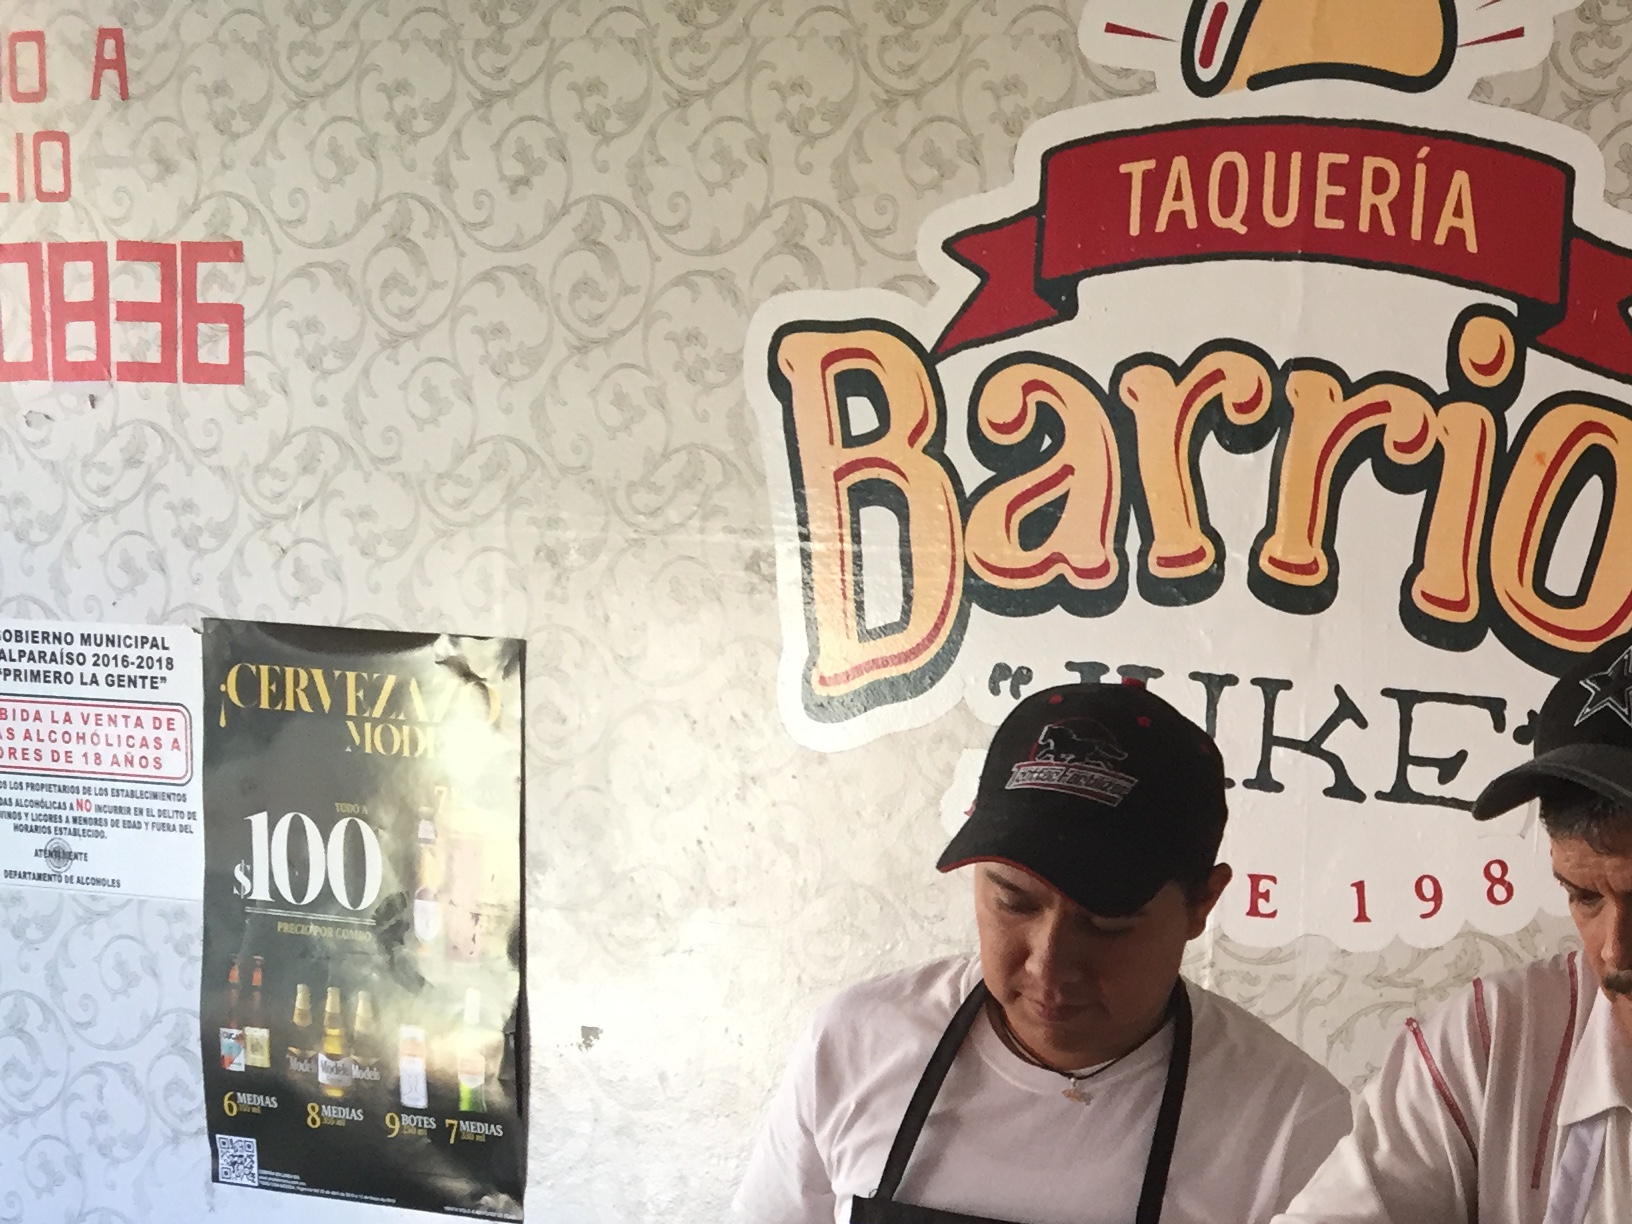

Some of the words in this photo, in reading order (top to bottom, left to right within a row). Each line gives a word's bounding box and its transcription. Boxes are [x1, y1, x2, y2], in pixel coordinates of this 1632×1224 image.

[91, 28, 129, 101] A
[0, 130, 71, 203] IO
[1119, 147, 1478, 253] TAQUERÍA
[0, 629, 74, 646] OBIERNO
[80, 633, 169, 650] MUNICIPAL
[92, 653, 174, 671] 2016-2018
[80, 672, 99, 686] LA
[51, 710, 73, 725] LA
[80, 712, 144, 729] VENTA
[152, 716, 176, 731] DE
[23, 728, 163, 750] ALCOHÓLICAS
[171, 737, 181, 751] A
[51, 749, 73, 764] DE
[81, 751, 102, 766] 18
[110, 751, 163, 770] AÑOS
[25, 782, 80, 795] PROPIETARIOS
[94, 787, 109, 797] LOS
[76, 798, 92, 812] NO
[233, 811, 382, 911] $100
[1350, 859, 1515, 923] 198
[223, 1091, 238, 1117] 6
[236, 1092, 278, 1109] MEDIAS
[307, 1102, 321, 1129] 8
[321, 1104, 364, 1121] MEDIAS
[385, 1112, 400, 1138] 9
[401, 1114, 437, 1130] BOTES
[445, 1119, 459, 1144] 7
[459, 1120, 504, 1137] MEDIAS
